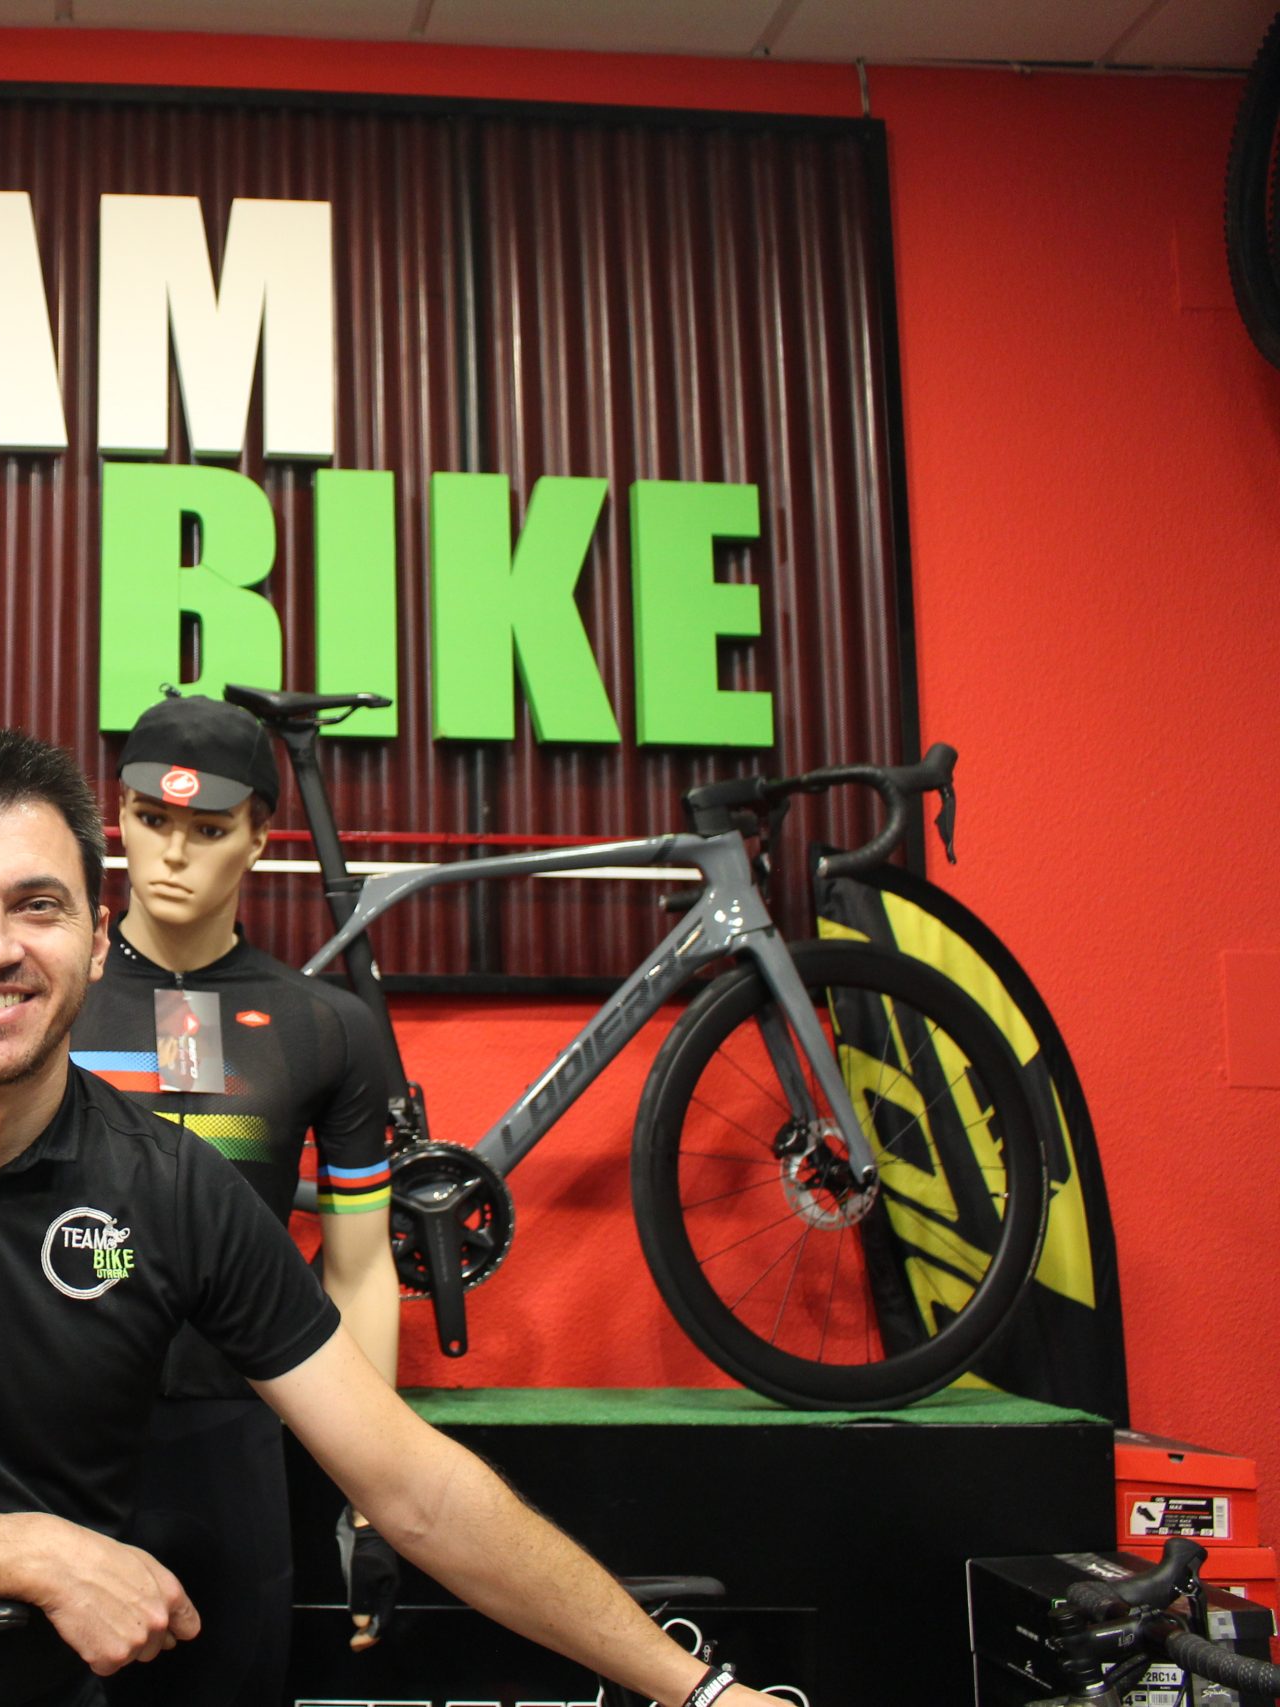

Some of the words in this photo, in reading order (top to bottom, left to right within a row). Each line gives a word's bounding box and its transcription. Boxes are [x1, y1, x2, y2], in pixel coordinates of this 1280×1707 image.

[99, 463, 774, 748] BIKE
[61, 1226, 110, 1250] TEAM
[93, 1248, 134, 1270] BIKE
[96, 1268, 130, 1279] UTRERA
